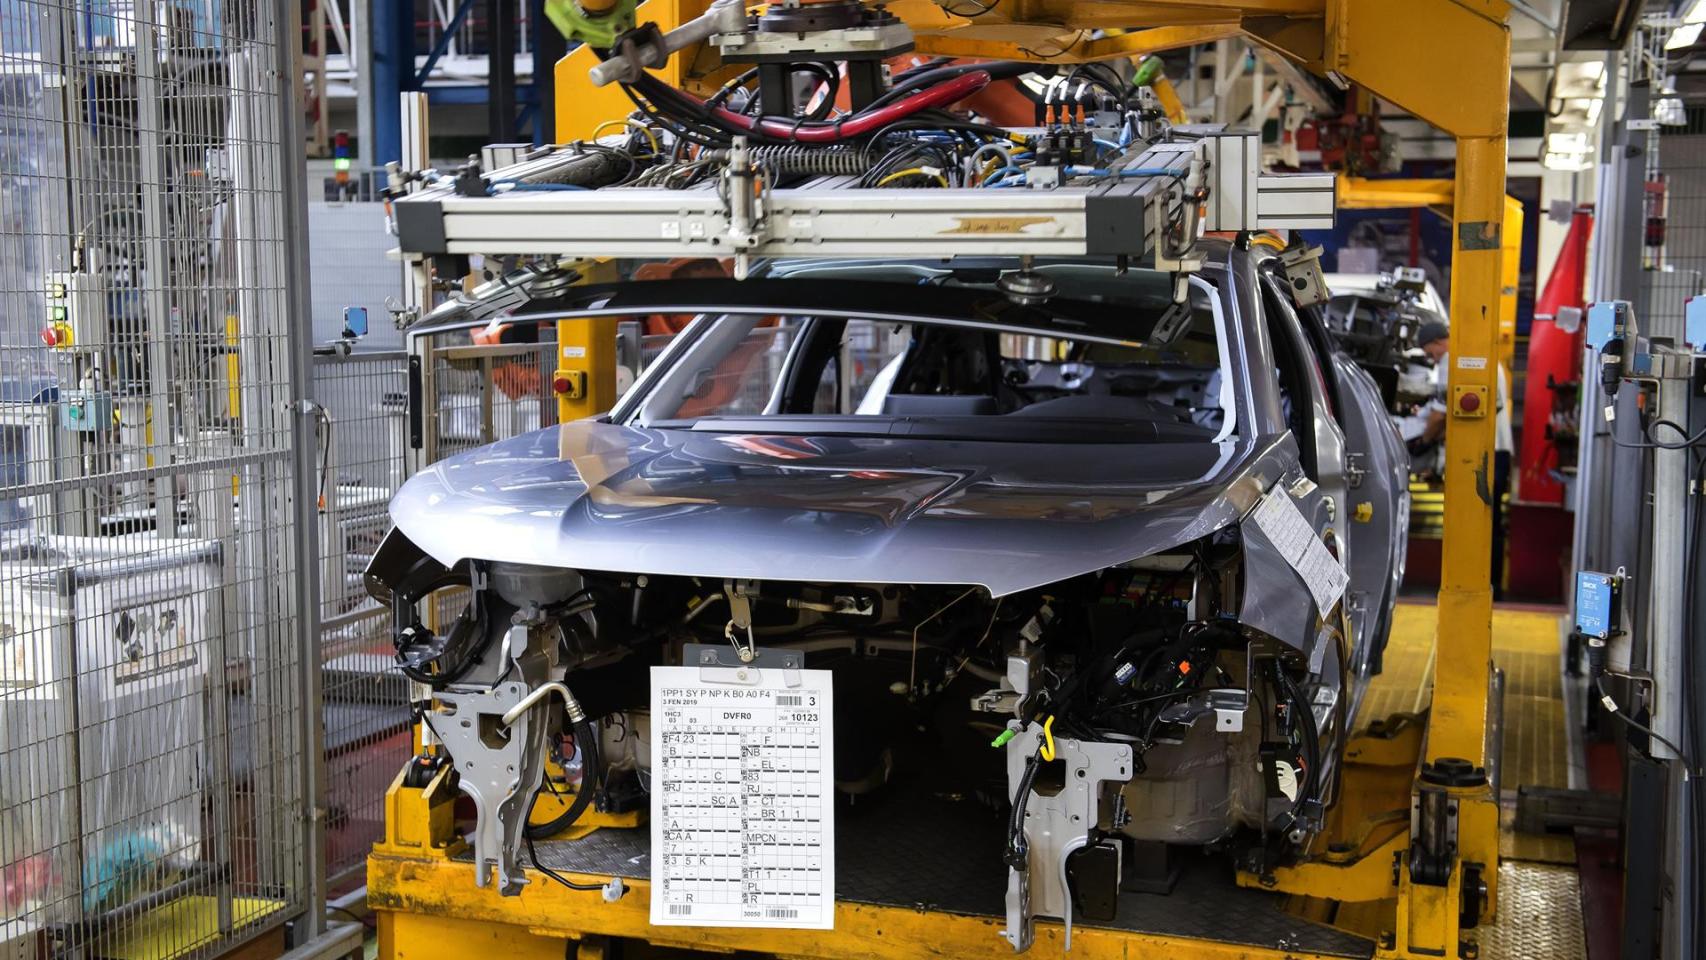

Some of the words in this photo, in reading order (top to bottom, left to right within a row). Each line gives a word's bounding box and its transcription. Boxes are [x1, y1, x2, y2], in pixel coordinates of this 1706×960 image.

[686, 690, 698, 698] SY
[701, 690, 707, 698] P
[709, 690, 721, 698] NP
[809, 696, 816, 706] 3
[792, 713, 818, 722] 10123
[669, 735, 680, 743] F4
[683, 735, 695, 743] 23
[765, 736, 771, 744] F
[670, 747, 676, 755] B
[747, 748, 761, 756] NB
[762, 761, 774, 769] EL
[714, 772, 722, 780] C
[668, 784, 681, 792] RJ
[747, 785, 760, 793] RJ
[712, 796, 725, 805] SC
[730, 797, 737, 805] A
[762, 810, 775, 818] BR
[671, 821, 679, 829] A
[668, 832, 682, 841] CA
[685, 833, 692, 841] A
[671, 844, 677, 852] 7
[671, 857, 677, 865] 3
[686, 857, 691, 865] 5
[700, 857, 706, 865] K
[748, 883, 760, 891] PL
[686, 894, 693, 902] R
[751, 895, 758, 903] R
